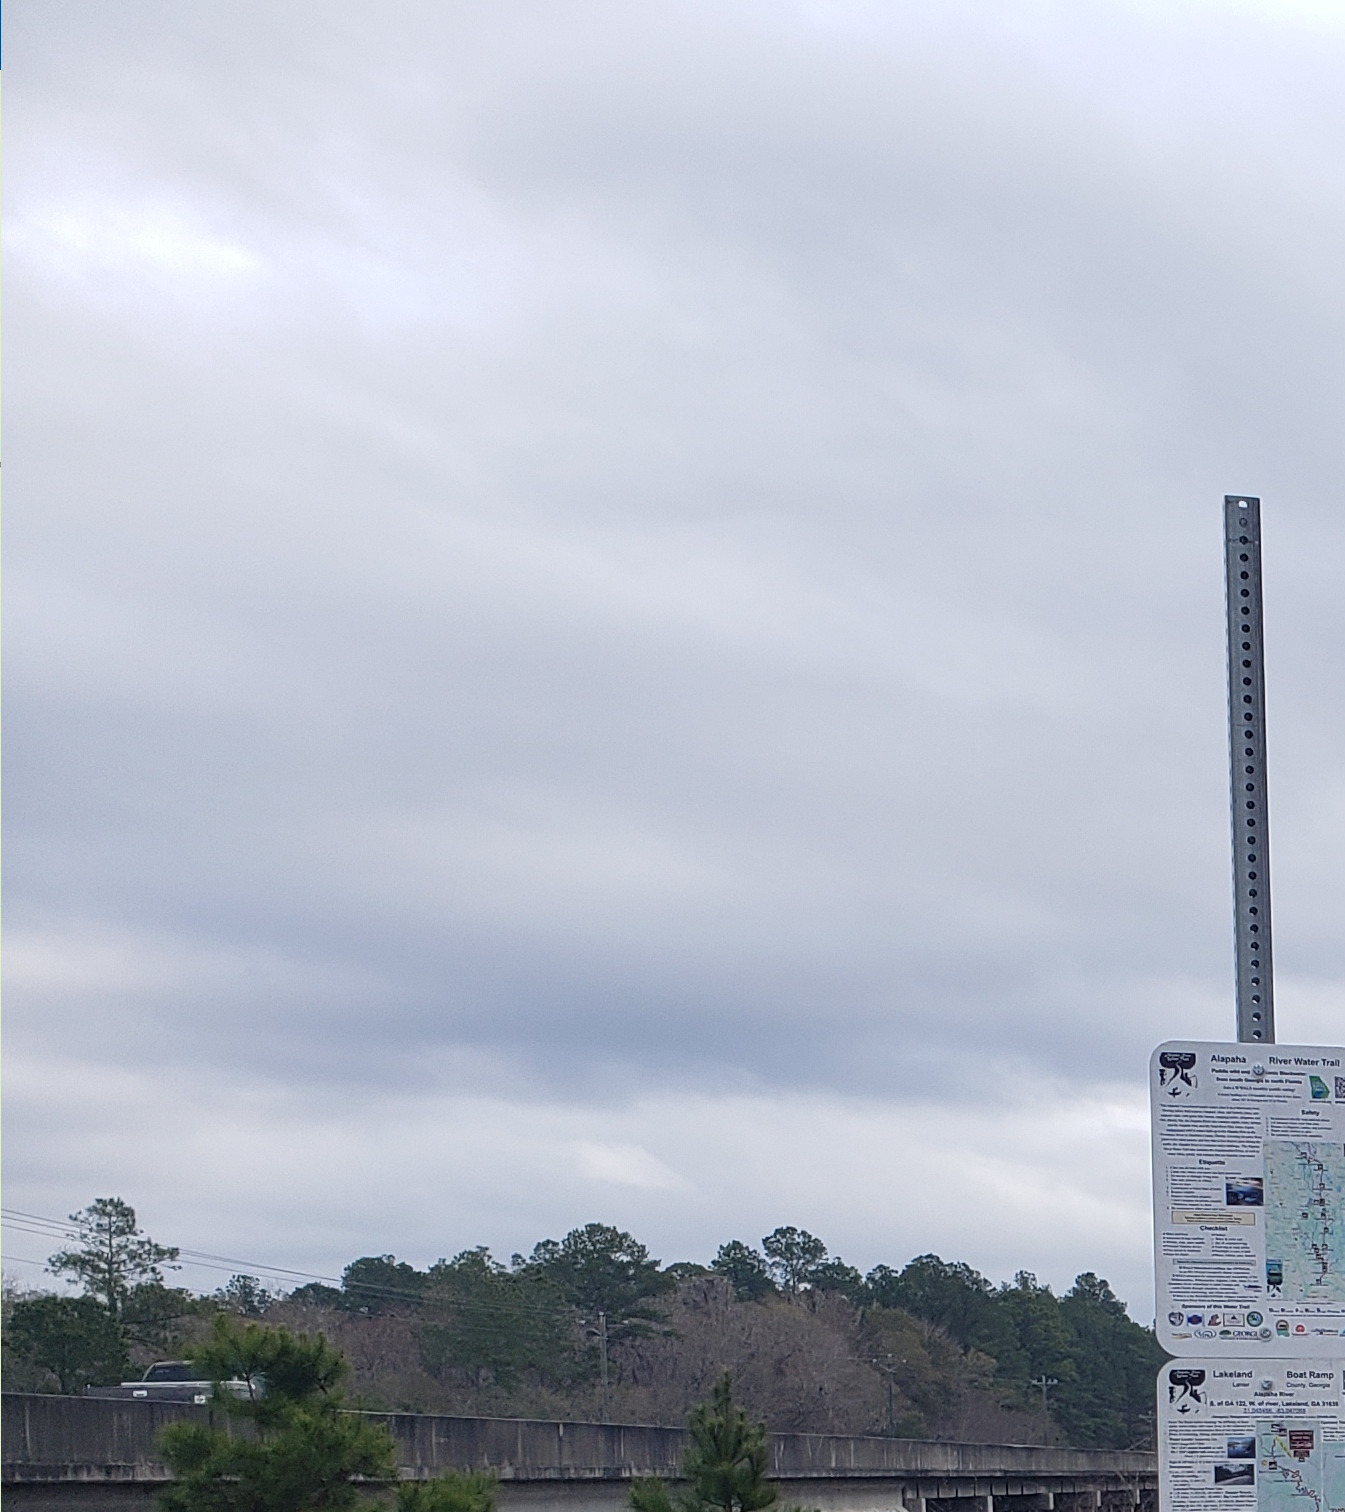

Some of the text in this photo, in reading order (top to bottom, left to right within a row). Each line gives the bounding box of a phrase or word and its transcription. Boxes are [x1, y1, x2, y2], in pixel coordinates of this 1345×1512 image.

[1211, 1054, 1340, 1067] Alapaha River Water Trail
[1301, 1109, 1320, 1117] Safety
[1213, 1370, 1334, 1380] Lakeland Boat Ramp
